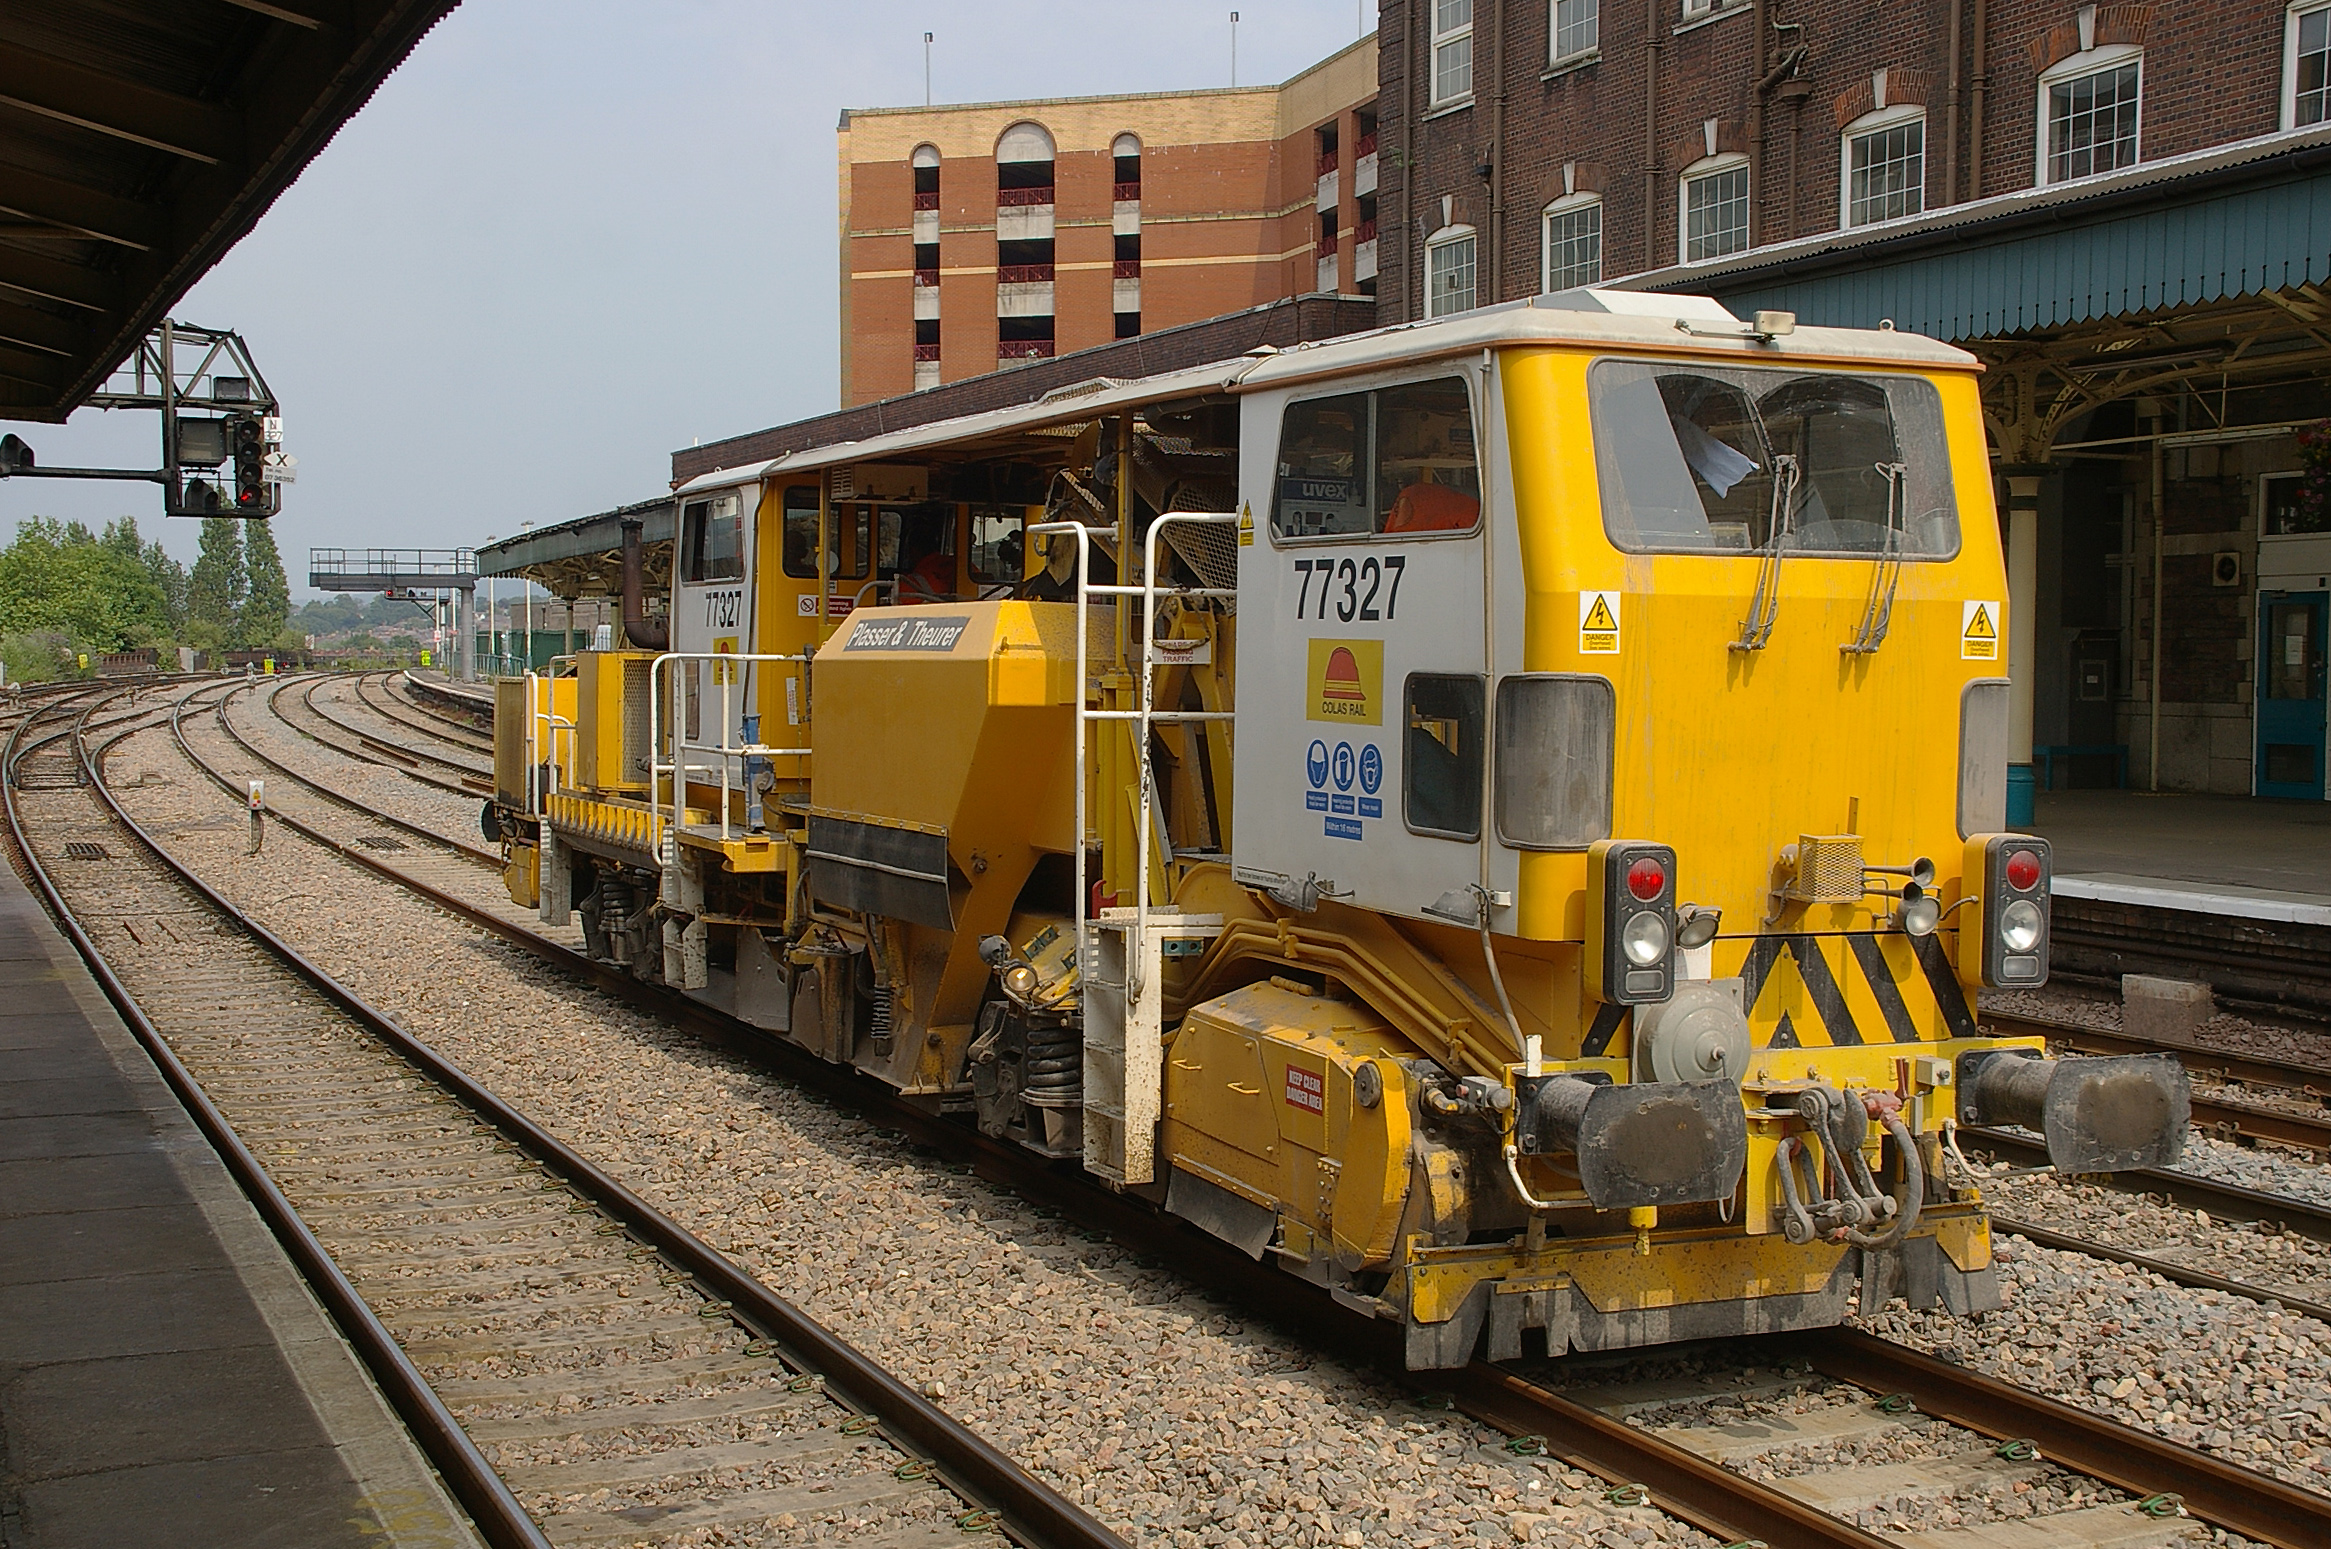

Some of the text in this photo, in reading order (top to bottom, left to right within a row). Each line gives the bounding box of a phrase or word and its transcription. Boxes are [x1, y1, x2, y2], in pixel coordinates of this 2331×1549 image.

[270, 419, 277, 430] N
[265, 430, 283, 441] 327
[276, 453, 288, 467] X
[1302, 482, 1346, 498] uvex
[1294, 555, 1406, 623] 77327
[705, 590, 742, 628] 77327
[847, 620, 963, 647] Plasser & Theurer
[1322, 701, 1367, 717] COLAS RAIL
[1289, 1070, 1320, 1093] KEEP CLEAR
[1286, 1086, 1322, 1110] DANGER AREA
